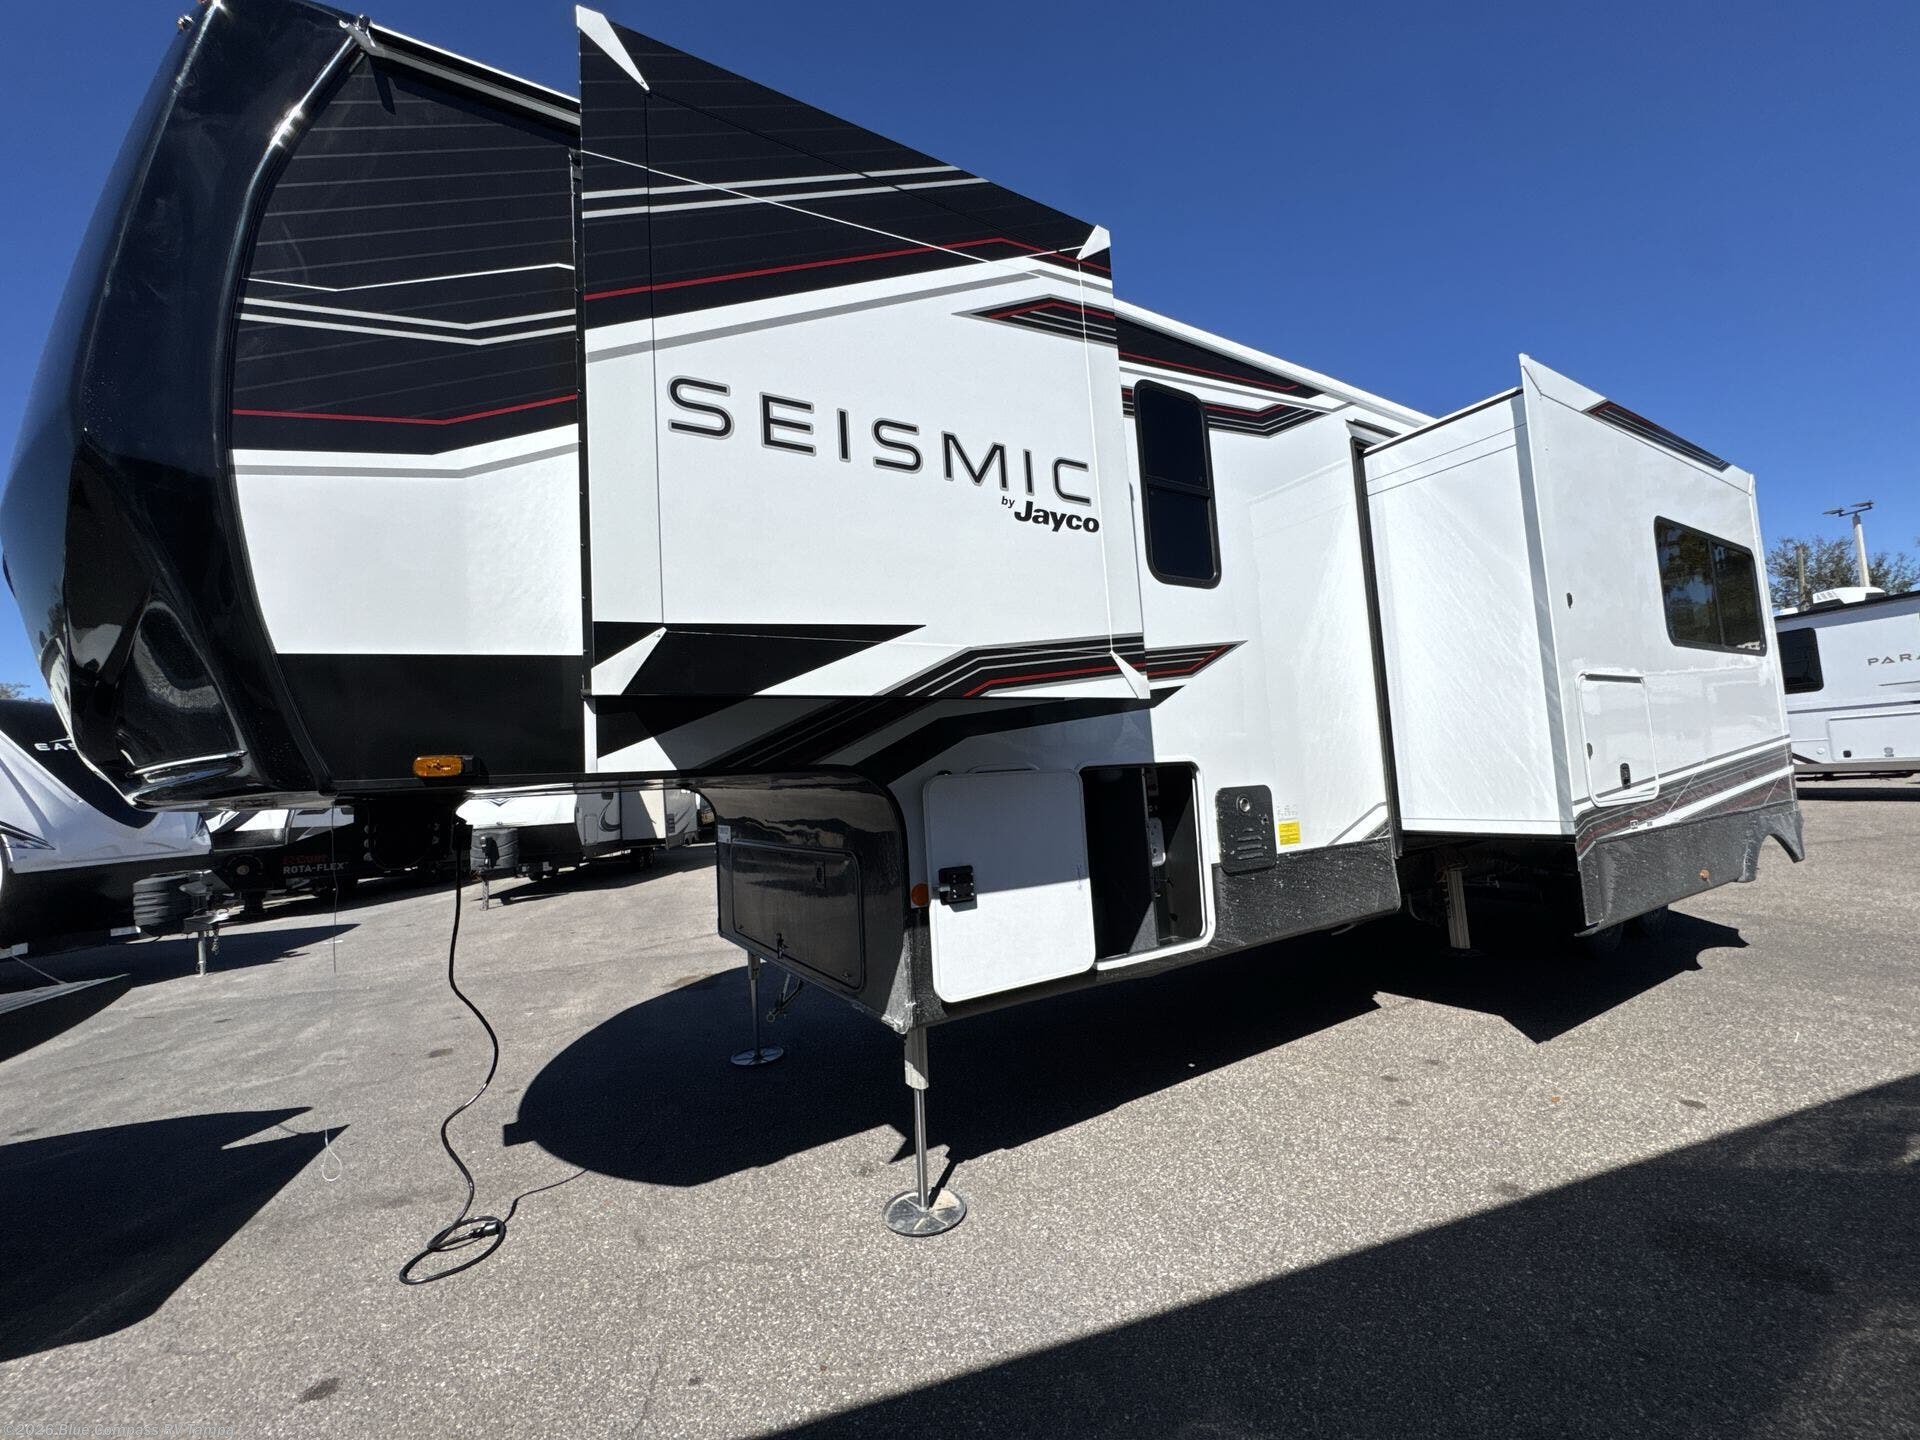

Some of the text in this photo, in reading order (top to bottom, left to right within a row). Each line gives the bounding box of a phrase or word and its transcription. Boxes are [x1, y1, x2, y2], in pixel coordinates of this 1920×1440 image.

[667, 374, 1092, 507] SEISMIC
[1001, 496, 1099, 533] by Jayco
